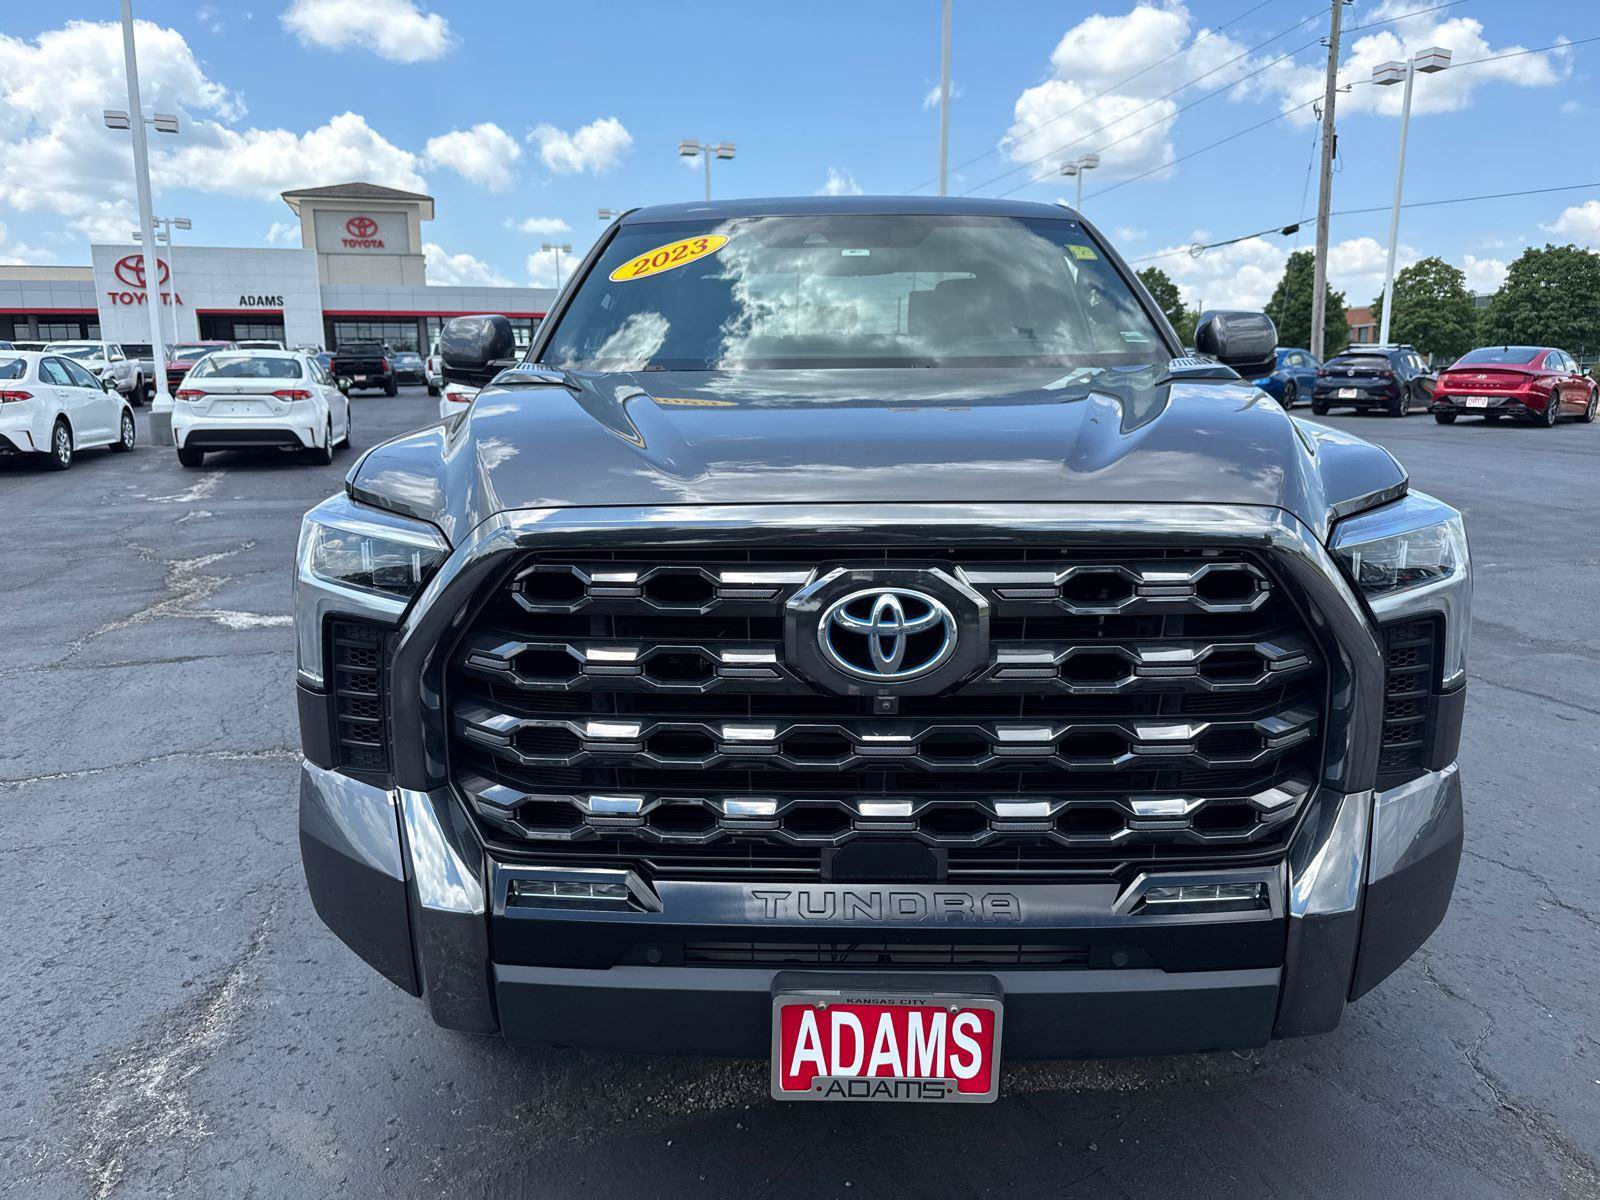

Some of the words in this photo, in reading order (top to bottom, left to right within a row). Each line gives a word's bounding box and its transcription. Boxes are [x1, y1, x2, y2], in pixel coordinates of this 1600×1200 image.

[342, 239, 385, 249] TOYOTA
[632, 238, 709, 276] 2023
[107, 292, 183, 306] TOYTA
[239, 295, 284, 307] ADAMS
[752, 890, 1022, 922] TUNDRA
[789, 1009, 983, 1080] ADAMS
[824, 1079, 945, 1100] ADAMS
